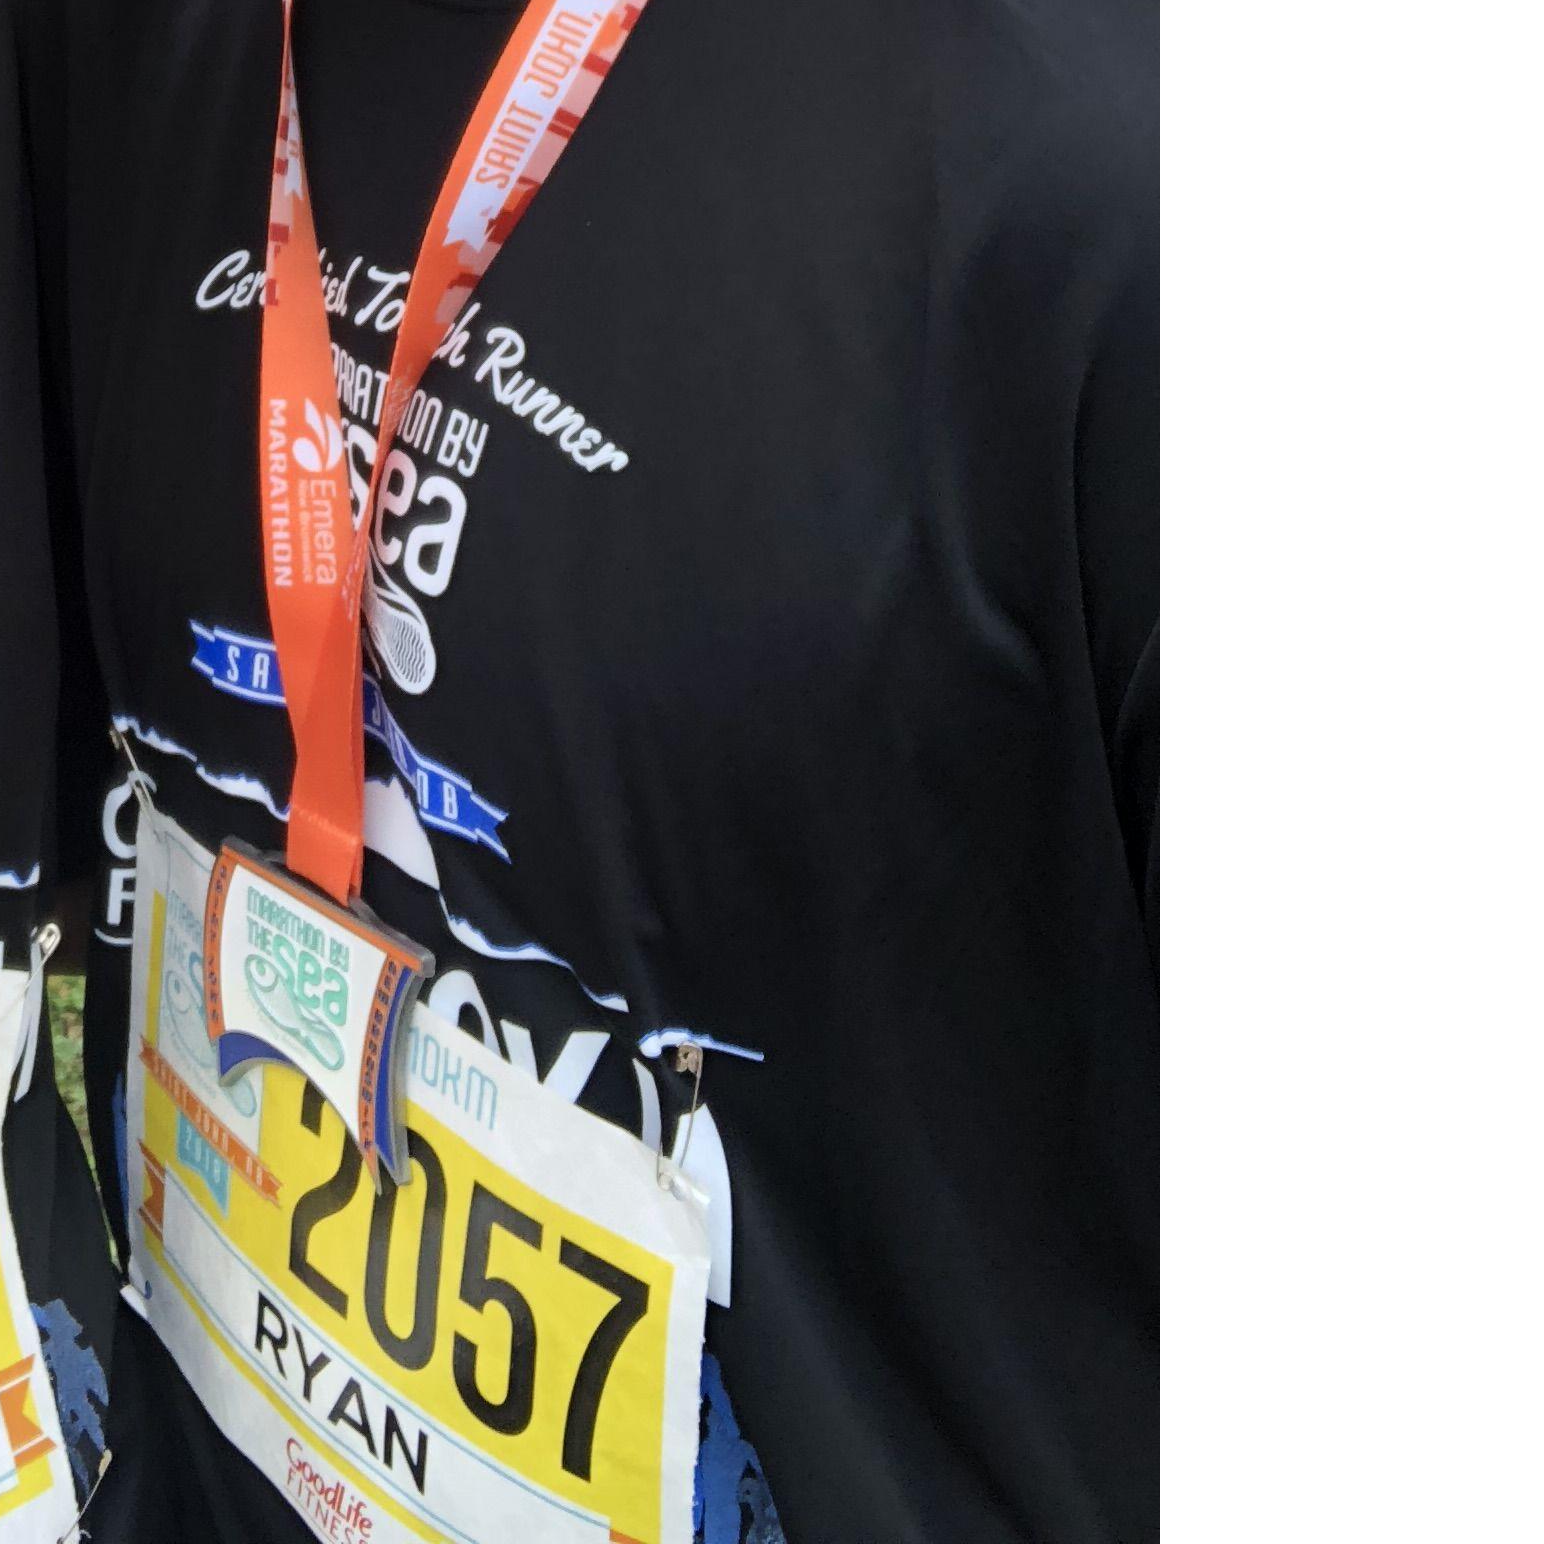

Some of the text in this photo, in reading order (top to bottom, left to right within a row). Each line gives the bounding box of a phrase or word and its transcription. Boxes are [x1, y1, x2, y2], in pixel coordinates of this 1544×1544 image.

[474, 100, 548, 190] SAINT
[522, 10, 604, 101] JOHN,
[354, 264, 482, 369] Toh
[475, 325, 630, 475] Runner
[268, 398, 293, 588] MARATHON
[436, 408, 490, 478] BY
[308, 478, 338, 586] Emera
[246, 885, 325, 957] MARATHON
[246, 914, 273, 955] THE
[288, 1075, 651, 1483] 2057
[255, 1291, 430, 1496] RYAN
[285, 1436, 374, 1539] GoodLife
